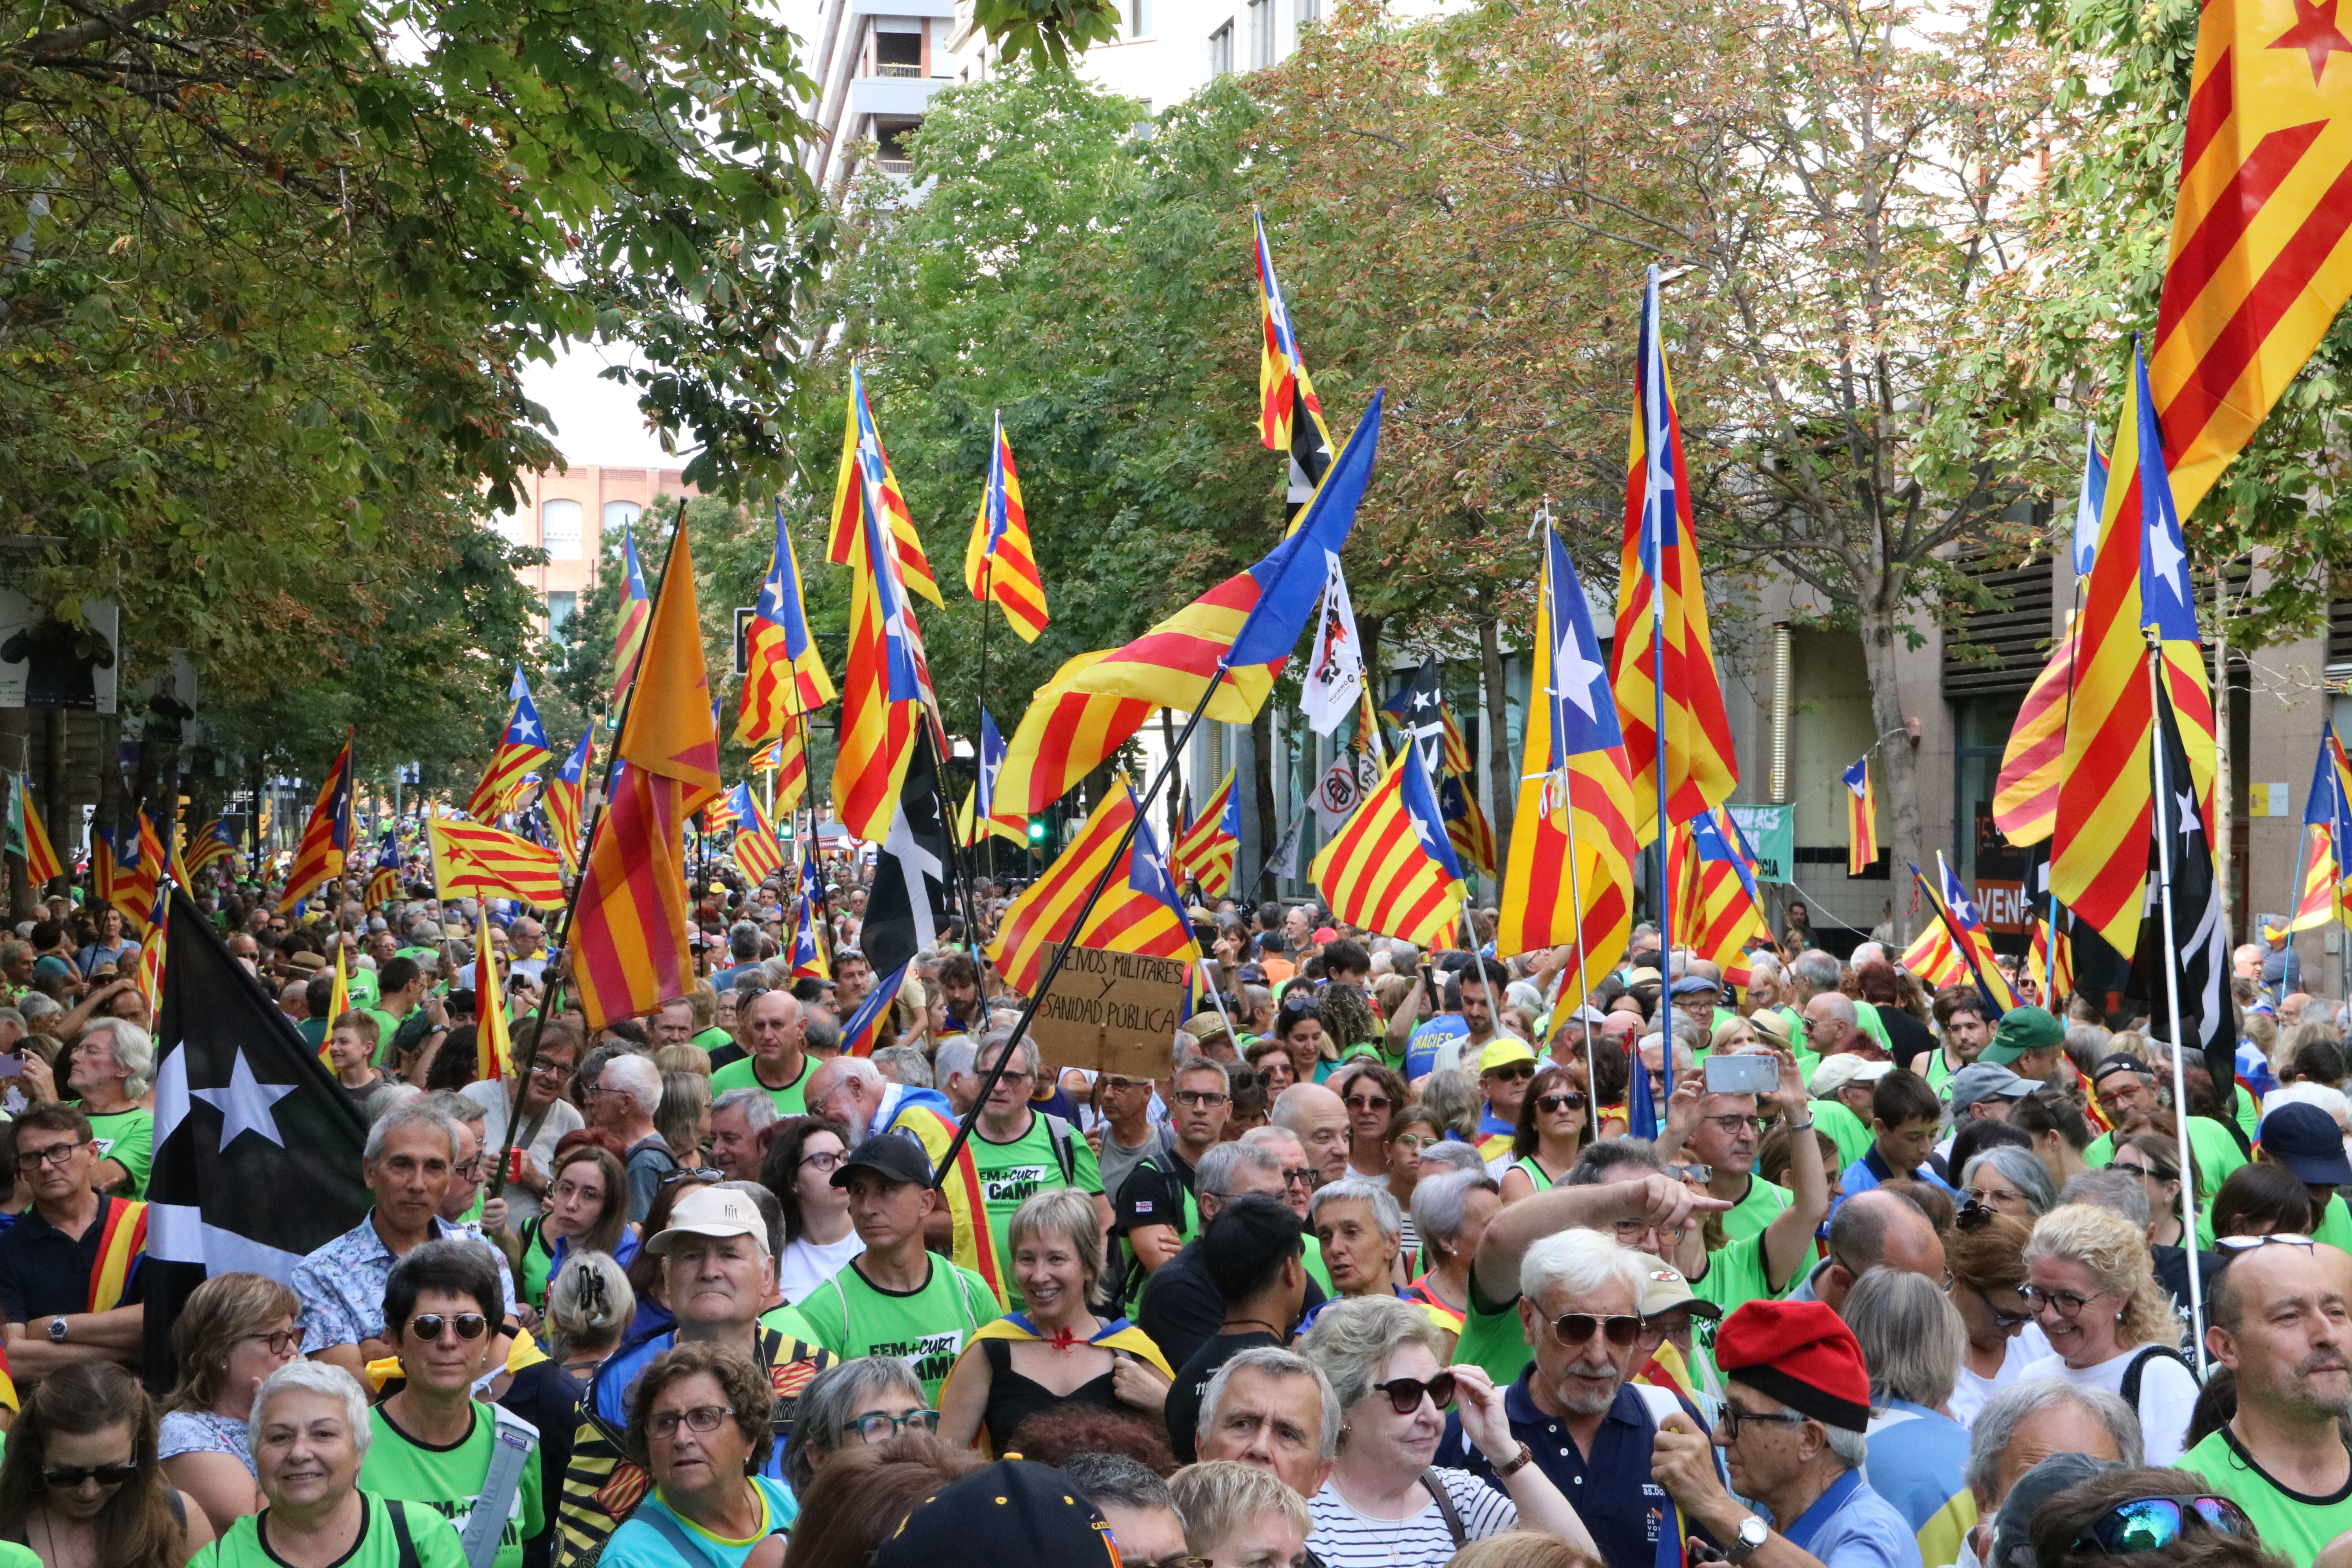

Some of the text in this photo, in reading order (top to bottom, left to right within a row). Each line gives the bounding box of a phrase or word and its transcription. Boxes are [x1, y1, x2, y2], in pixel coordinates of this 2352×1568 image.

[1977, 888, 2031, 926] VEN
[1113, 956, 1184, 984] MILITARES
[1098, 977, 1116, 999] Y
[1042, 993, 1175, 1034] SANIDAD PÚBLICA
[1412, 1031, 1453, 1052] GRÀCIES
